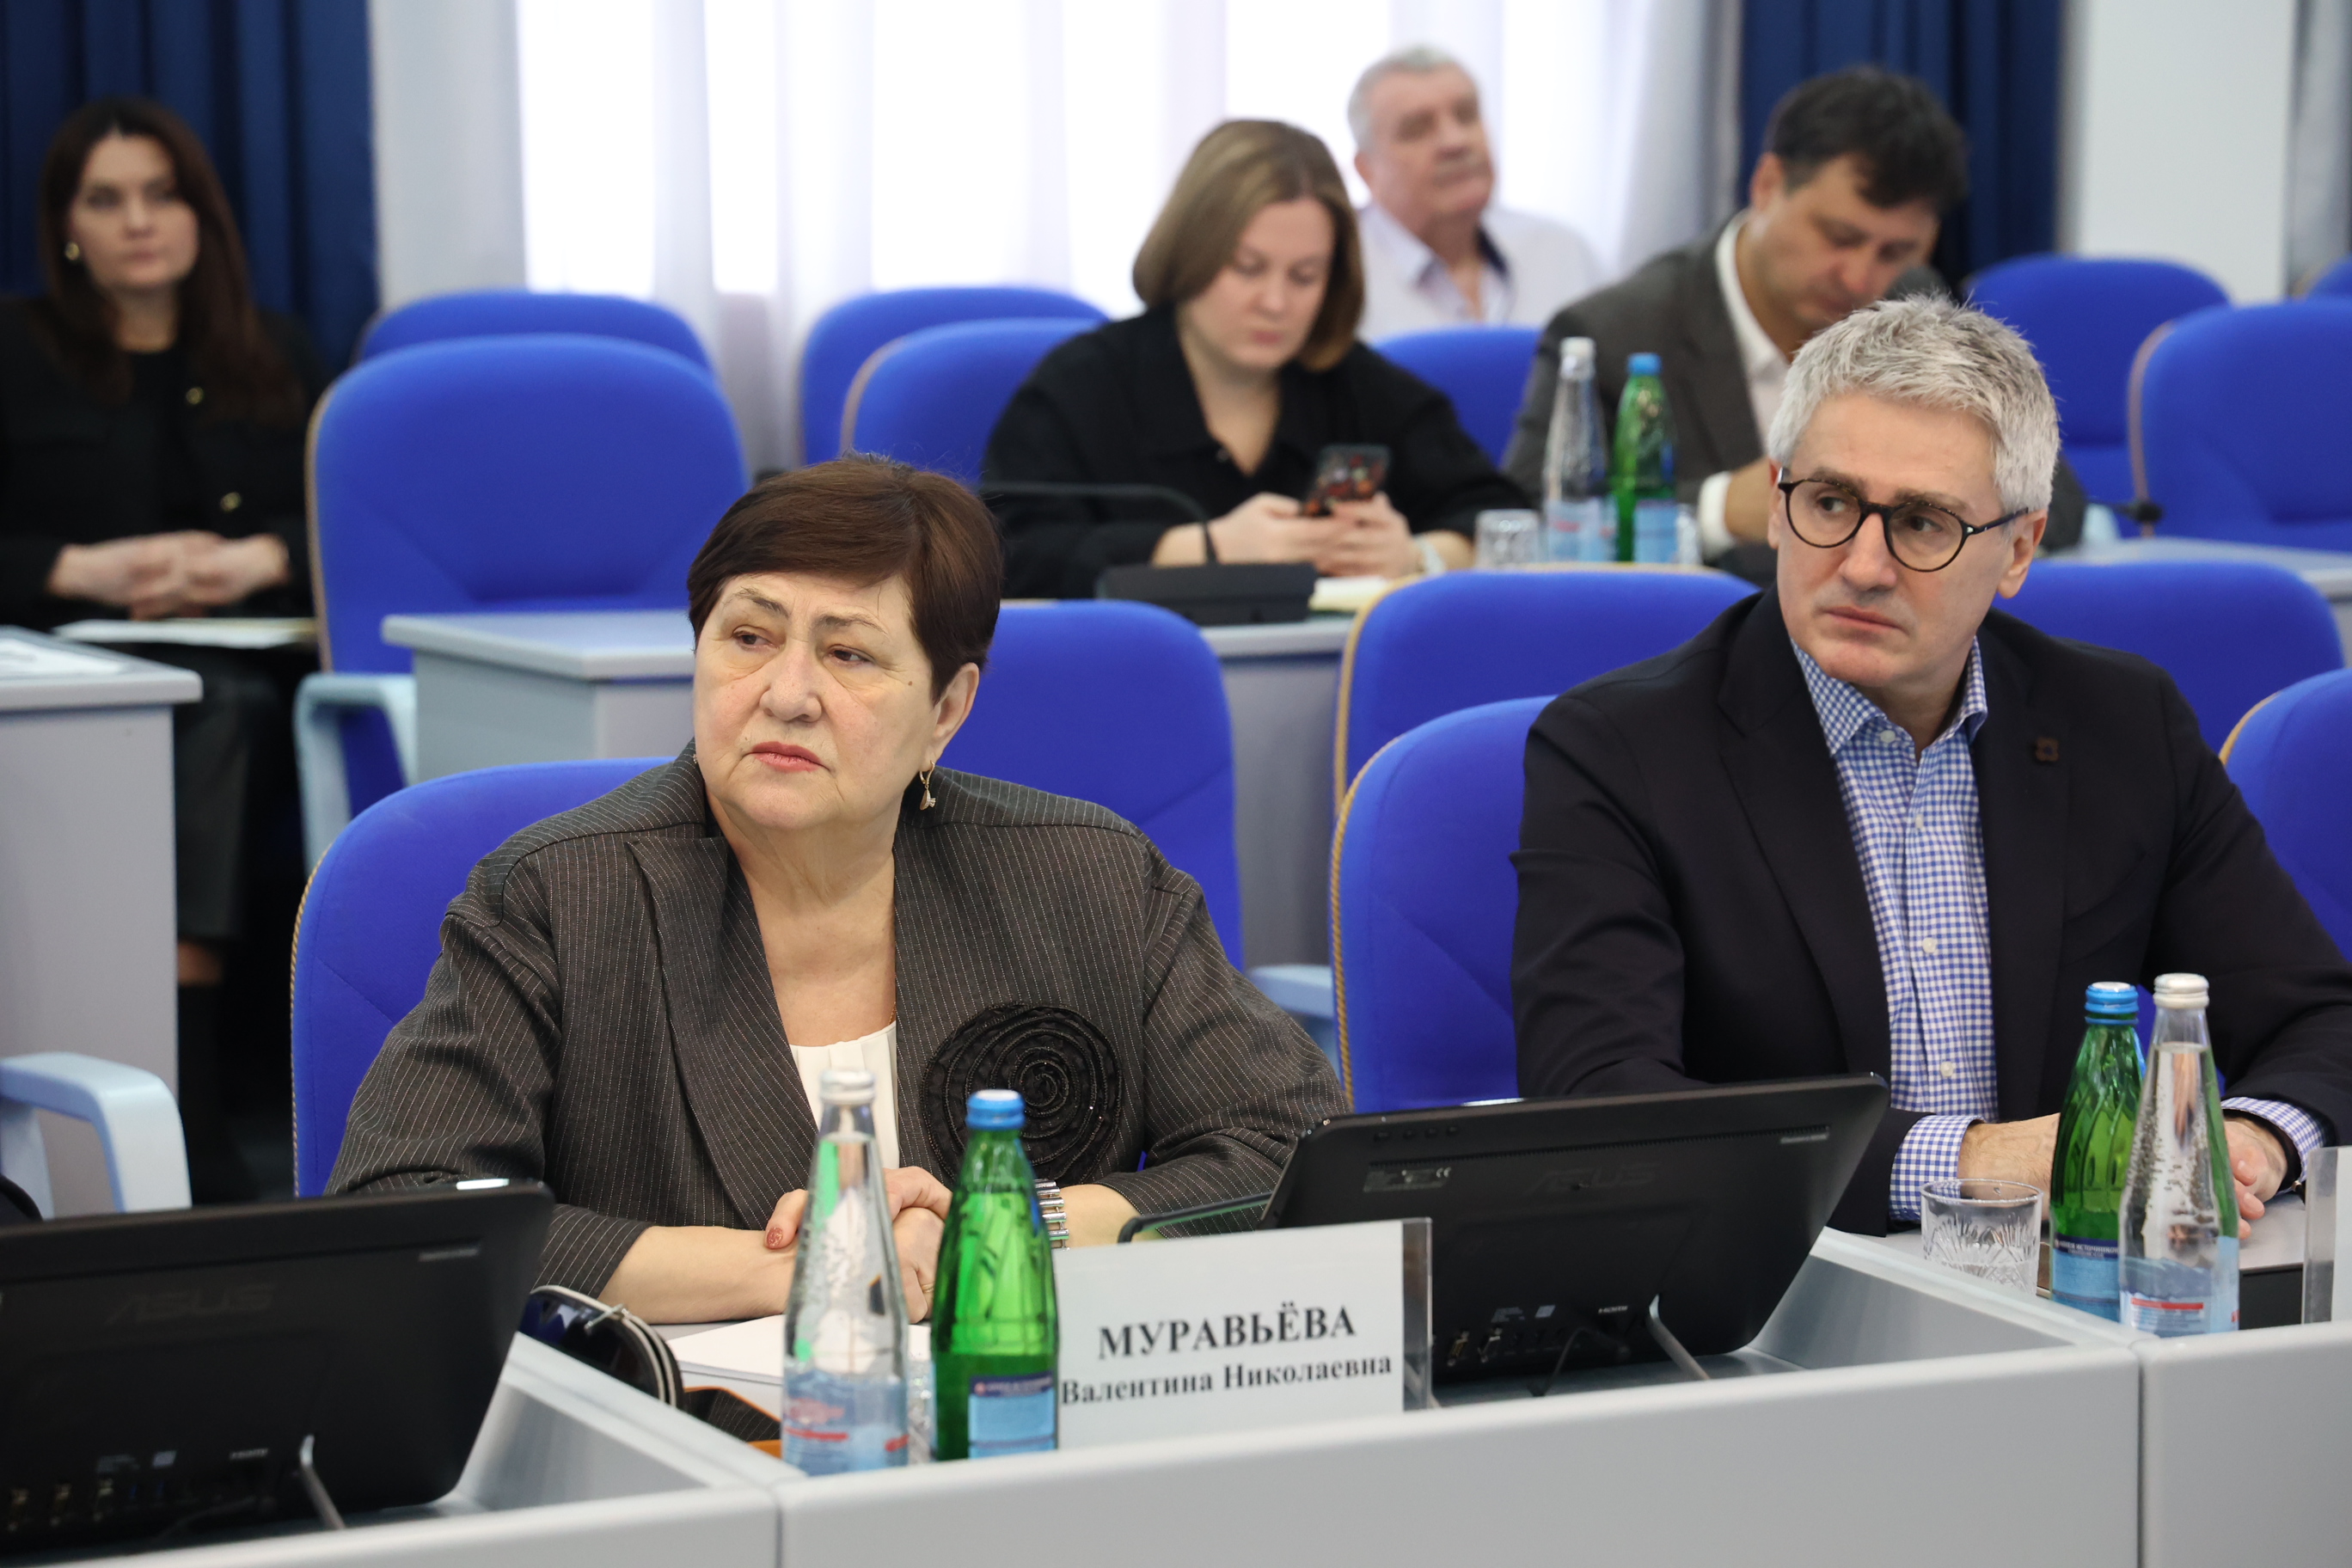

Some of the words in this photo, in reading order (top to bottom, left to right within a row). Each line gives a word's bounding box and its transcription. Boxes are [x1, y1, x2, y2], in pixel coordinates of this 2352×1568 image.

[104, 1283, 276, 1325] ASUS
[1098, 1302, 1356, 1360] МУРАВЬЁВА
[1062, 1371, 1213, 1406] Валентина
[1224, 1357, 1392, 1389] Николаевна
